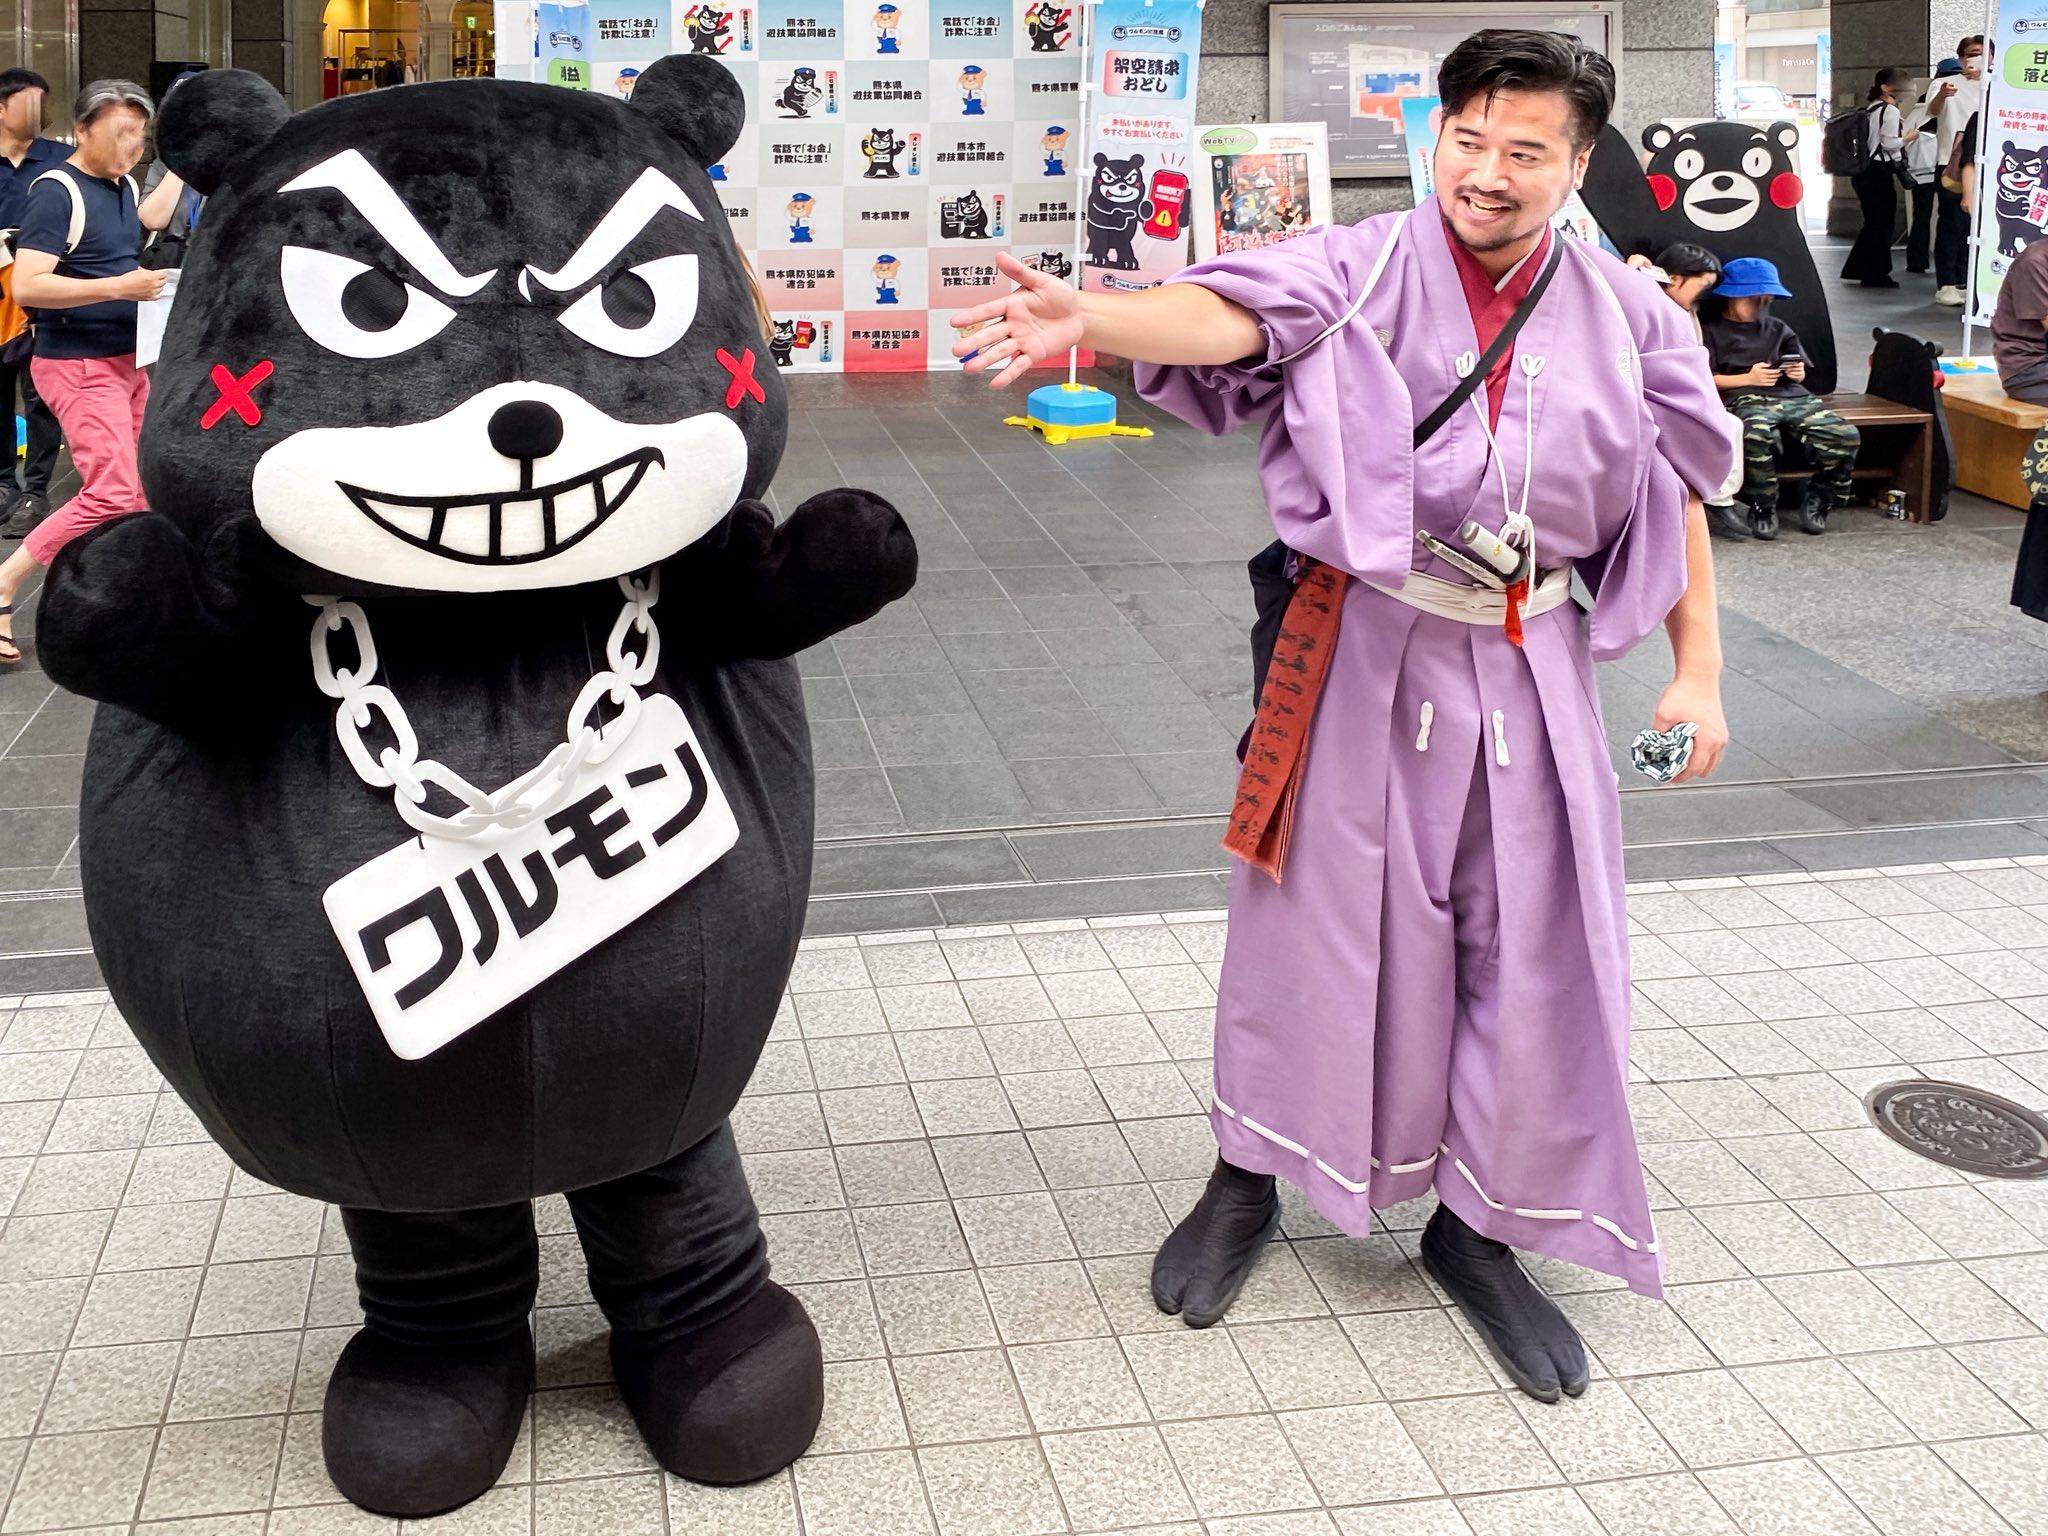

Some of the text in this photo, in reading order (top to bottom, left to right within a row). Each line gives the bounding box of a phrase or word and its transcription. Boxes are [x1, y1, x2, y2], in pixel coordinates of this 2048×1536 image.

[598, 19, 658, 28] 電話で「お金」
[787, 19, 816, 27] 熊本市
[943, 17, 1000, 28] 電話で「お金」
[601, 29, 655, 39] 詐欺に注意！
[767, 26, 836, 37] 遊技業協同組合
[945, 27, 997, 37] 詐欺に注意！
[1114, 56, 1181, 76] 架空請求
[873, 81, 902, 90] 熊本県
[1032, 82, 1078, 92] 熊本県警察
[1123, 77, 1167, 92] おどし
[853, 89, 922, 100] 遊技業協同組合
[1998, 108, 2048, 121] 私たちの将来
[1103, 128, 1184, 140] 今すぐお支払いください
[772, 144, 831, 153] 電話で「お金」
[957, 142, 986, 151] 熊本市
[774, 155, 827, 164] 詐欺に注意！
[937, 150, 1005, 162] 遊技業協同組合
[1039, 202, 1067, 211] 熊本県
[2029, 191, 2048, 222] 投資
[862, 211, 909, 220] 熊本県警察
[766, 269, 835, 279] 熊本県防犯協会
[941, 264, 1000, 278] 電話で「お金」
[786, 277, 815, 289] 連合会
[944, 275, 995, 286] 詐欺に注意！
[852, 330, 920, 339] 熊本県防犯協会
[870, 337, 903, 351] 連合会
[360, 742, 708, 1010] ワルモン
